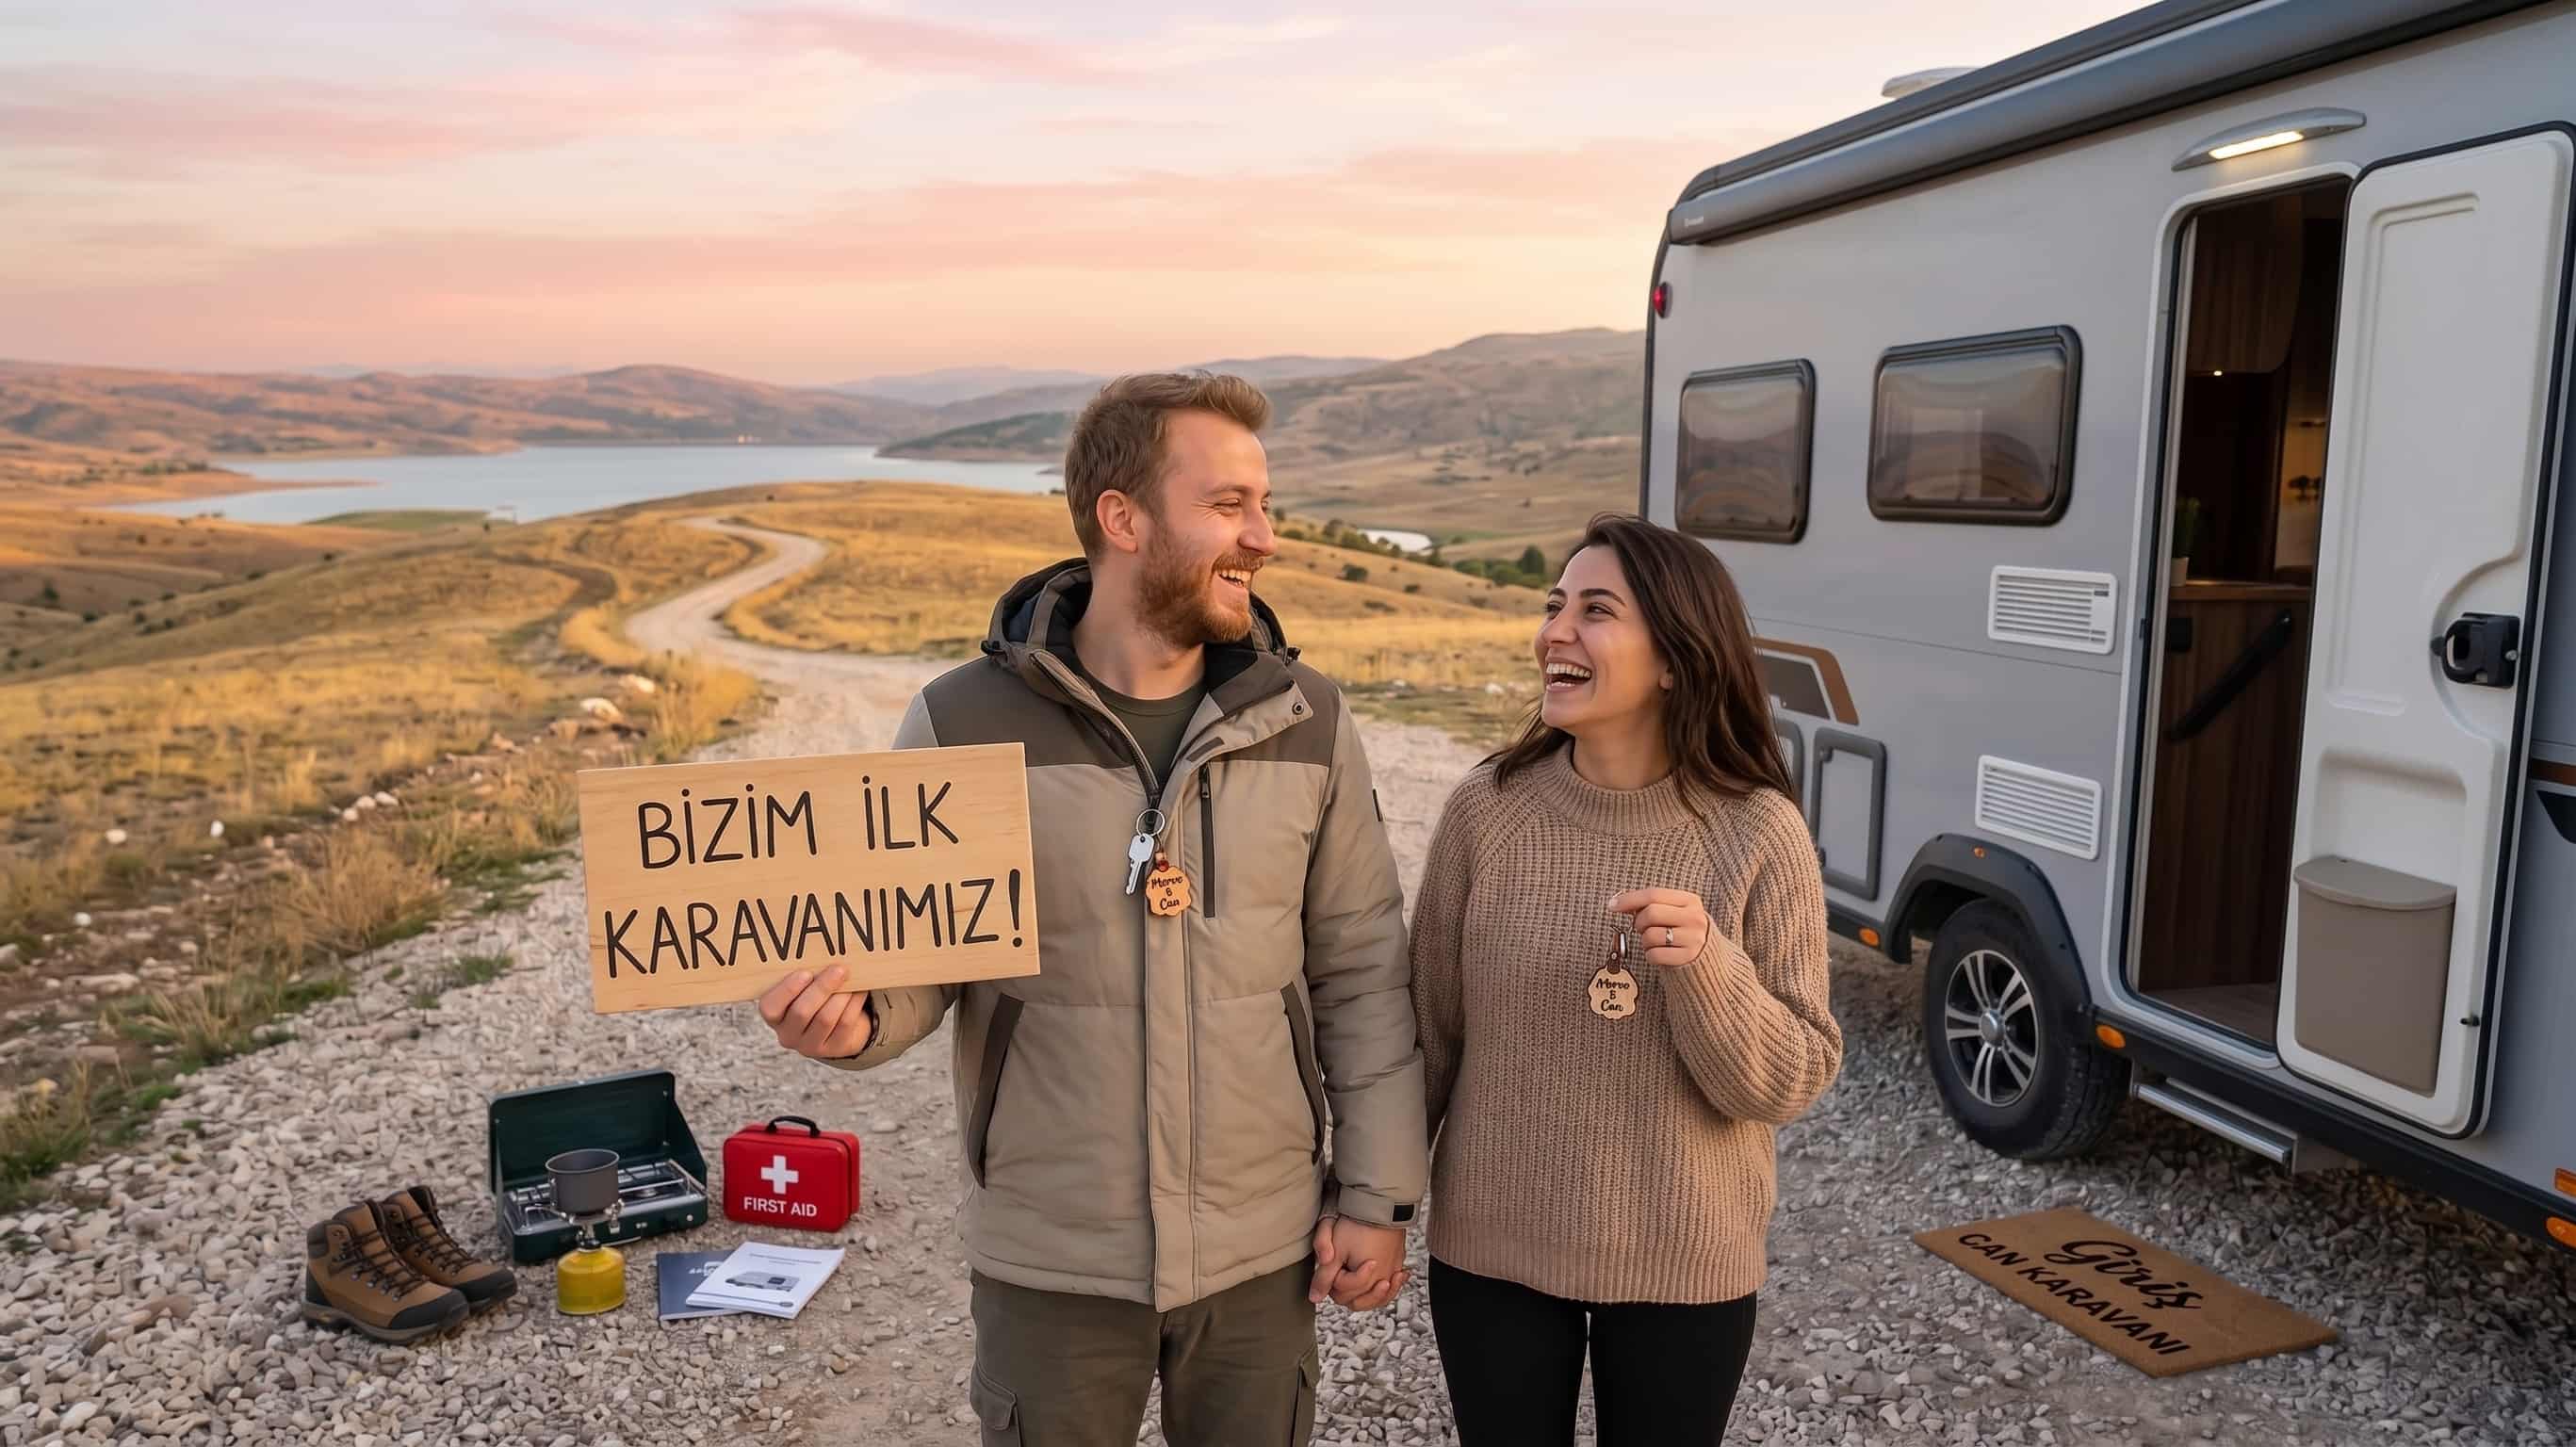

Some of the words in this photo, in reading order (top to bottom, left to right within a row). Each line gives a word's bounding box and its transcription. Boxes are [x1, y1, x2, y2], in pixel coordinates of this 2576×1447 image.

[637, 783, 818, 870] BİZİM
[861, 775, 959, 851] İLK
[604, 869, 1023, 979] KARAVANIMIZ!
[743, 1195, 786, 1214] FIRST
[791, 1201, 818, 1217] AID
[1958, 1233, 2030, 1266] CAN
[2016, 1265, 2193, 1357] KARAVANI
[2043, 1239, 2205, 1310] Giriş
